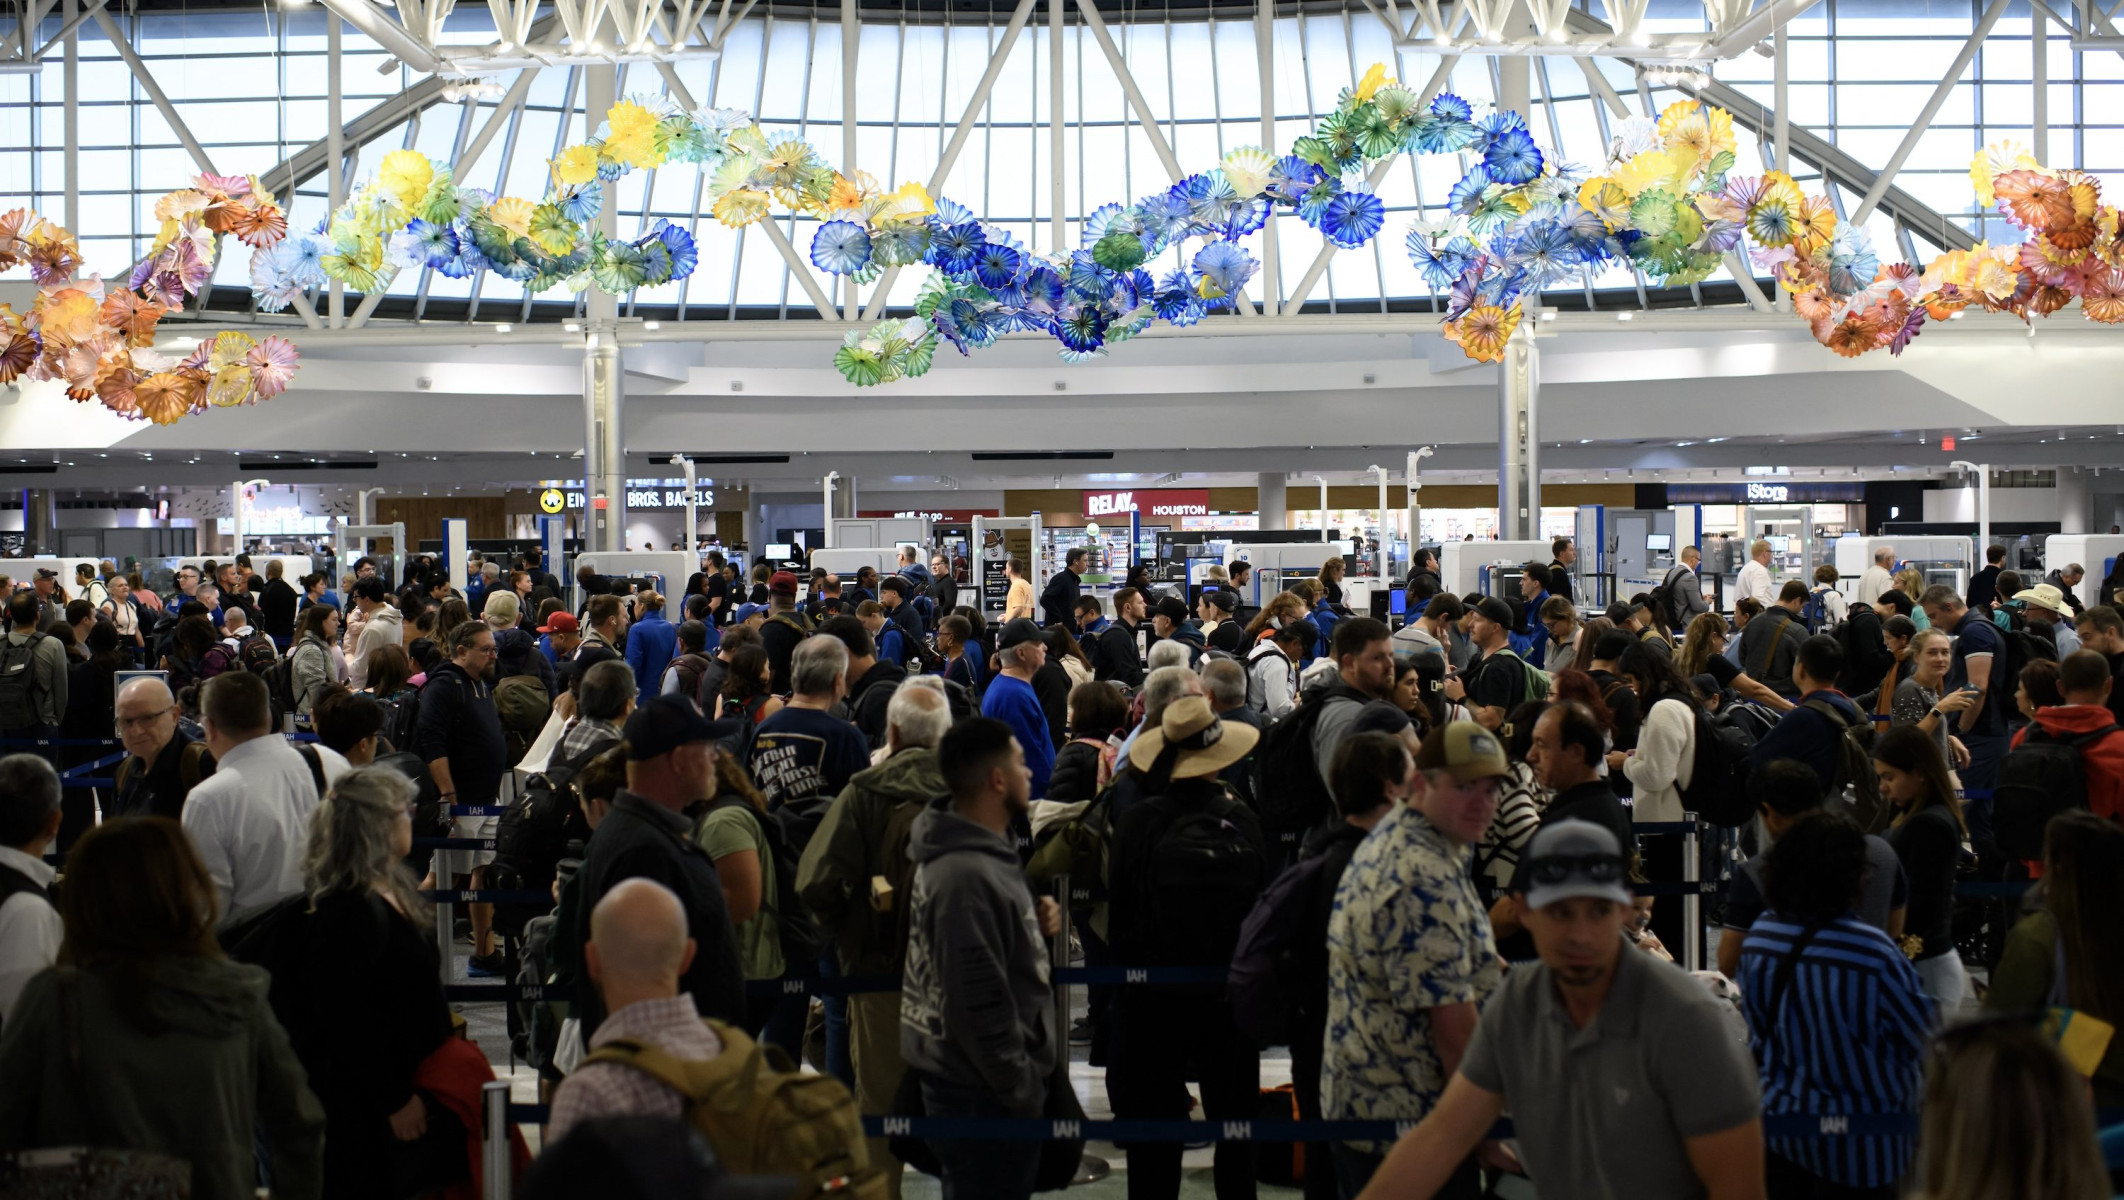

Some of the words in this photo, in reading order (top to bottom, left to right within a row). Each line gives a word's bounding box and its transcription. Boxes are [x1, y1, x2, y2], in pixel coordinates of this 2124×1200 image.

[1747, 483, 1788, 499] iStore
[628, 491, 662, 508] BROS.
[1089, 492, 1133, 516] RELAY
[1153, 505, 1206, 516] HOUSTON
[931, 513, 943, 522] go
[1621, 797, 1632, 806] AH
[469, 806, 484, 815] IAH
[1018, 837, 1029, 846] AH
[1281, 832, 1295, 842] IAH
[461, 891, 478, 901] IAH
[1072, 889, 1089, 900] IAH
[1126, 969, 1147, 983] IAH
[522, 986, 542, 999] IAH
[783, 980, 804, 994] IAH
[883, 1116, 910, 1136] IAH
[1052, 1119, 1080, 1139] IAH
[1223, 1121, 1252, 1140] IAH
[1820, 1115, 1849, 1135] IAH
